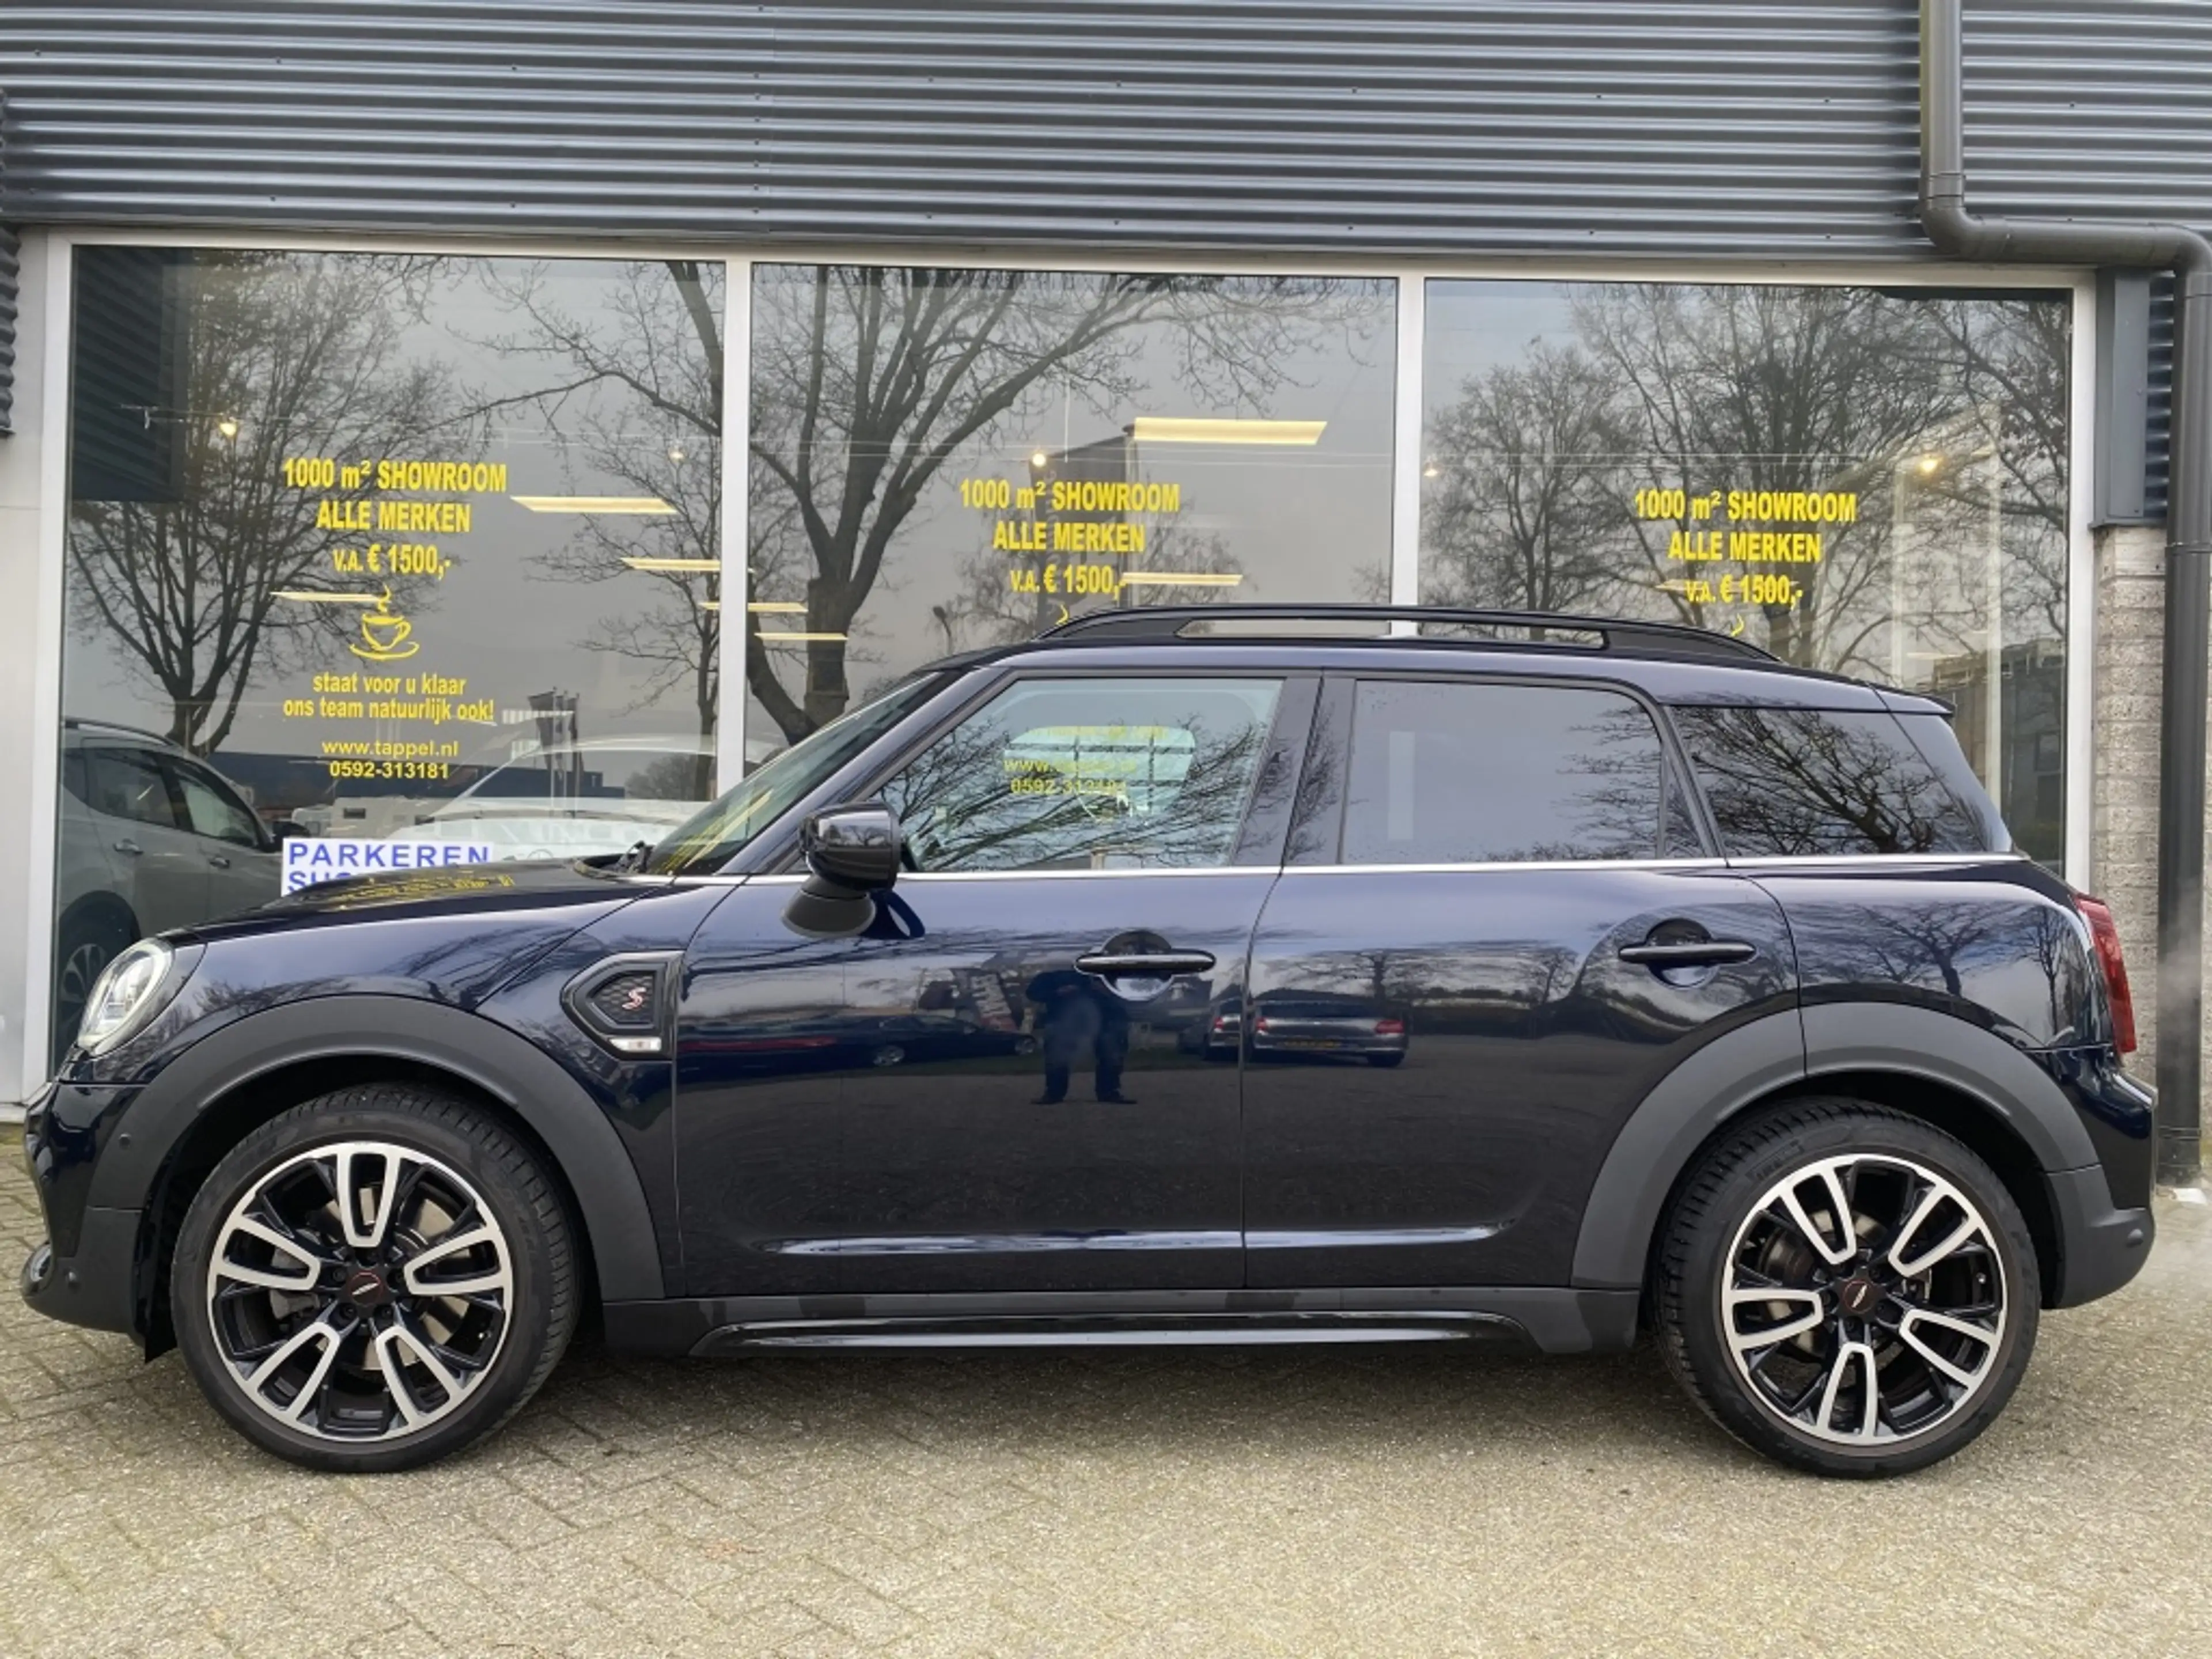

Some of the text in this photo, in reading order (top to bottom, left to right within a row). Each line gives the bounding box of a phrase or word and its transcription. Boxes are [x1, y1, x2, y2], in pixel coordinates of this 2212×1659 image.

[284, 458, 334, 488] 1000
[377, 461, 506, 492] SHOWROOM
[960, 479, 1010, 509] 1000
[1052, 481, 1180, 512] SHOWROOM
[1635, 488, 1685, 519] 1000
[1728, 491, 1857, 524] SHOWROOM
[316, 499, 471, 533] ALLE MERKEN
[993, 520, 1145, 552] ALLE MERKEN
[1667, 531, 1823, 563] ALLE MERKEN
[332, 544, 452, 580] V.A. € 1500,-
[1010, 563, 1127, 601] V.A. € 1500,-
[1684, 574, 1804, 611] V.A. € 1500,-
[313, 673, 467, 695] staat voor u klaar
[283, 697, 494, 725] ons team natuurlijk ook!
[322, 739, 459, 761] www.tappel.nl
[329, 760, 450, 779] 0592-313181
[289, 843, 489, 867] PARKEREN
